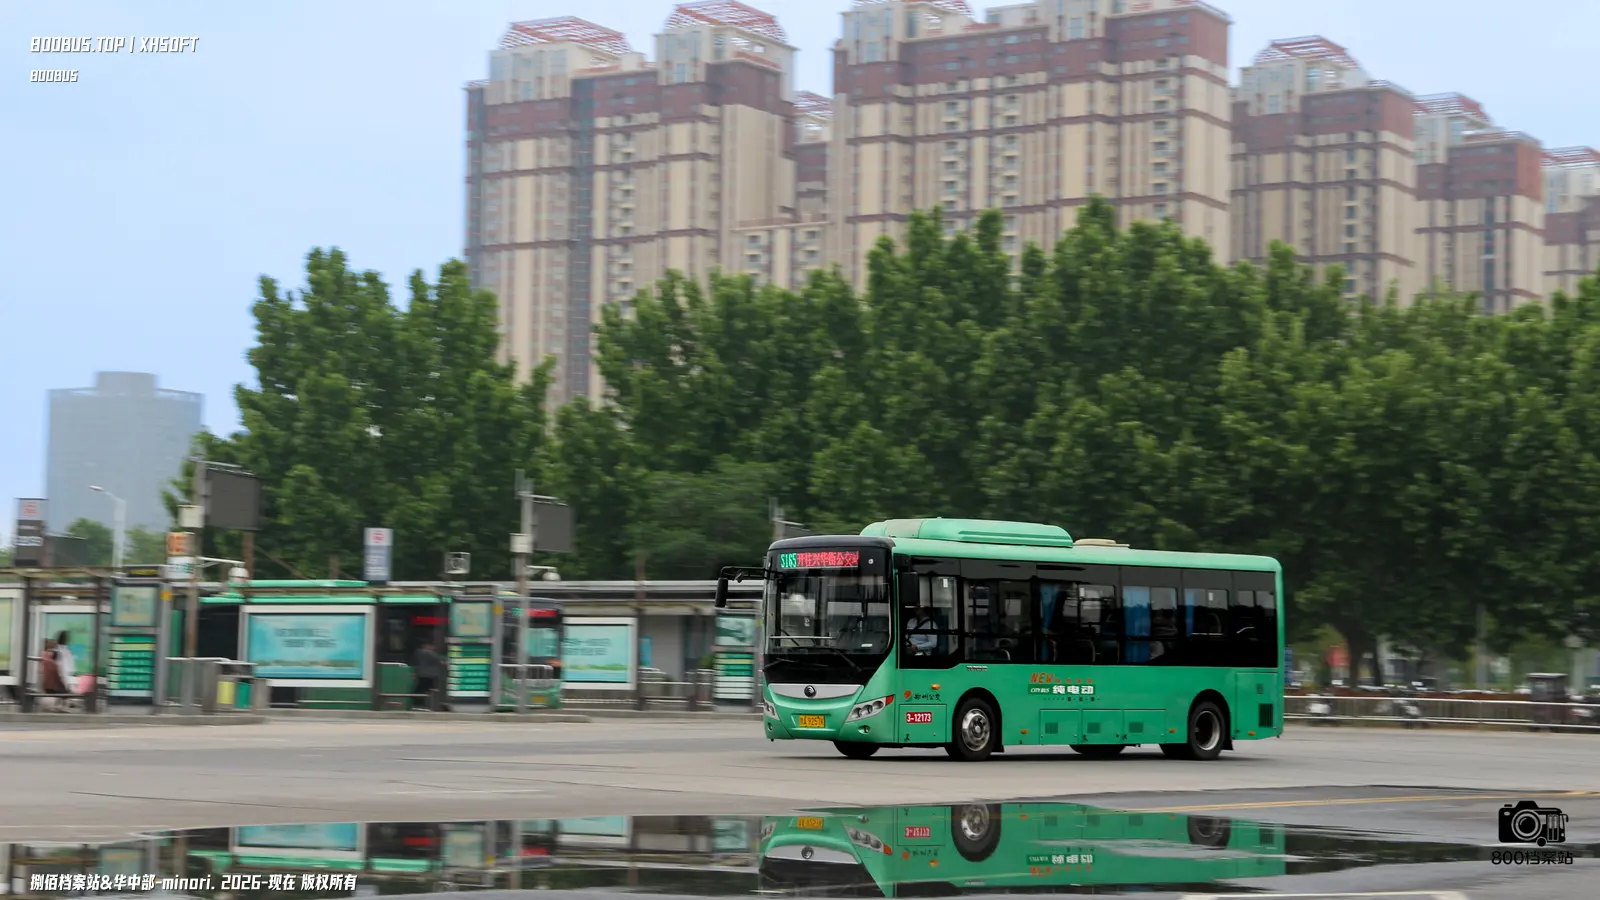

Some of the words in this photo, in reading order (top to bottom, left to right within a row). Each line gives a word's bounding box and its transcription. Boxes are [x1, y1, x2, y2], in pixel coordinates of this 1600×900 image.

[780, 553, 797, 568] S165
[1030, 672, 1054, 683] NEW
[1052, 685, 1094, 694] 纯电动
[906, 713, 932, 722] 3-12173
